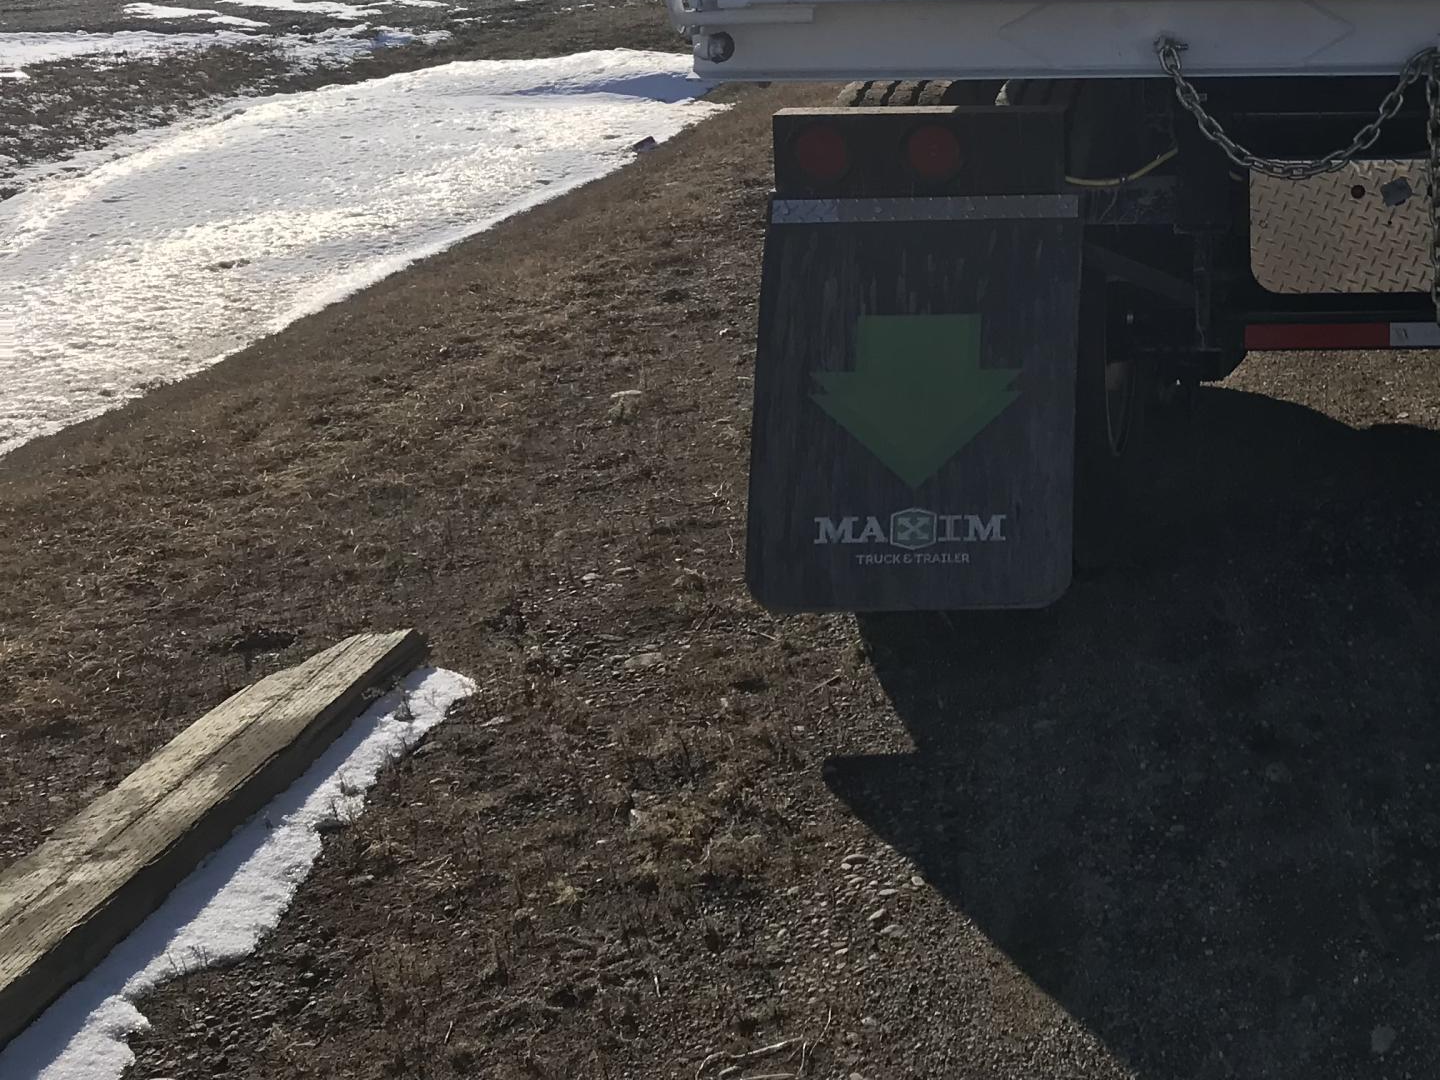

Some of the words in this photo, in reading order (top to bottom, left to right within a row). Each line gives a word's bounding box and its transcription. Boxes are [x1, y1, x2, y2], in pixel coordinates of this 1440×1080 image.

[813, 513, 1007, 545] MAXIM
[855, 554, 901, 566] TRUCK
[914, 552, 970, 565] TRAILER
